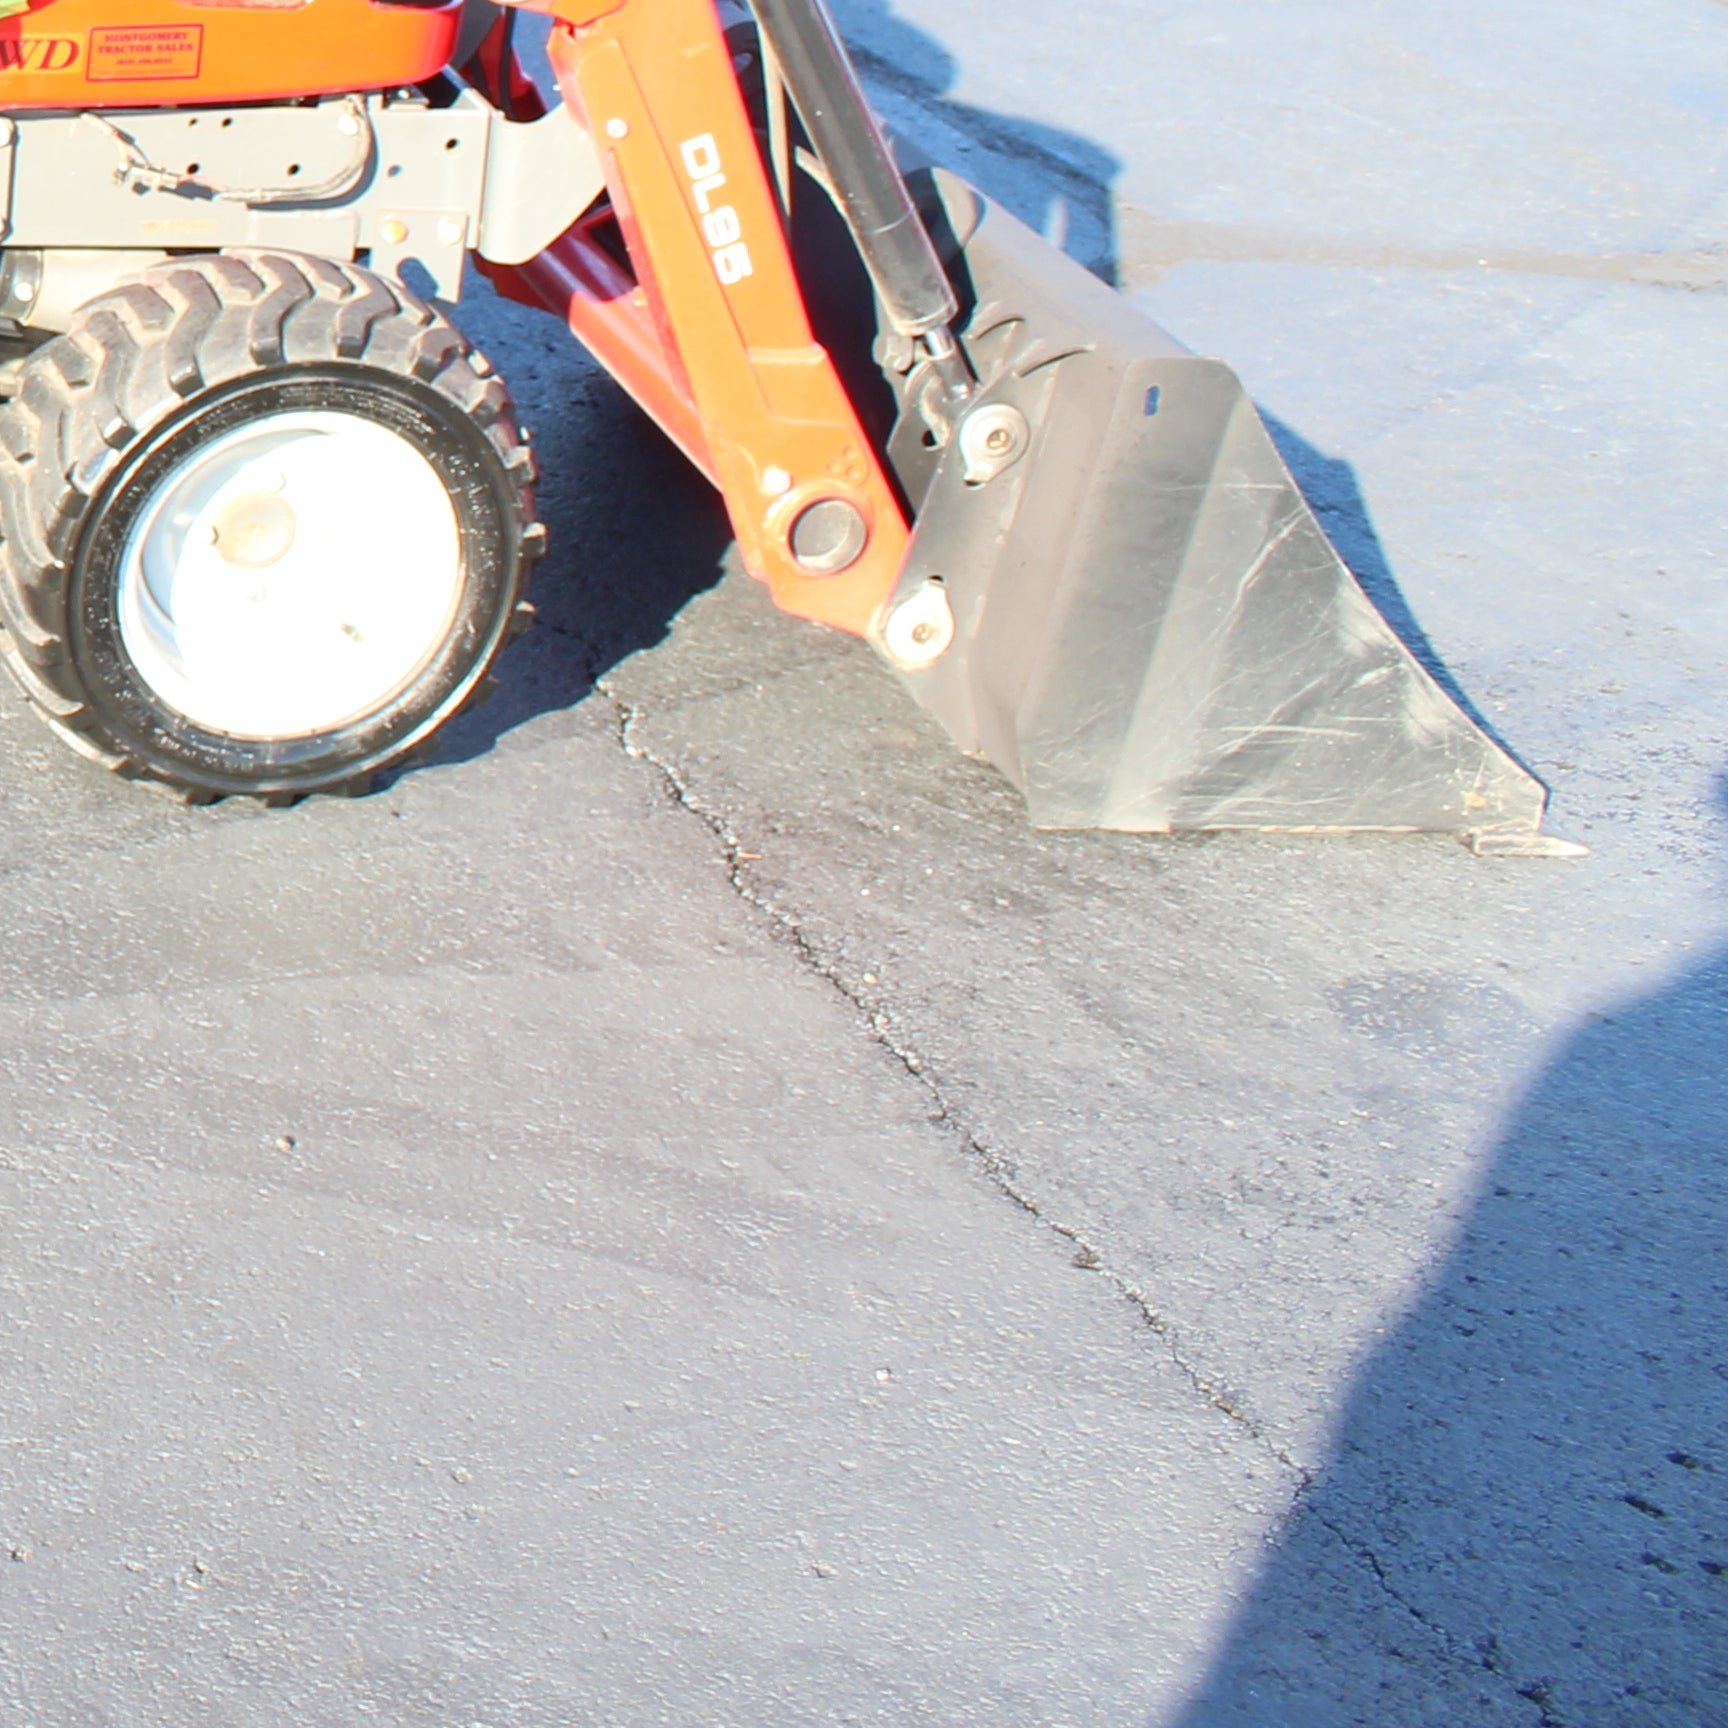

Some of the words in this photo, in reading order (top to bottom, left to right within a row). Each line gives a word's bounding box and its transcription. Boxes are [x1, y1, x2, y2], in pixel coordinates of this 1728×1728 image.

[104, 32, 189, 43] MONTGOMERY
[98, 44, 153, 54] TRACTOR
[156, 42, 194, 52] SALES
[679, 132, 753, 285] DL95
